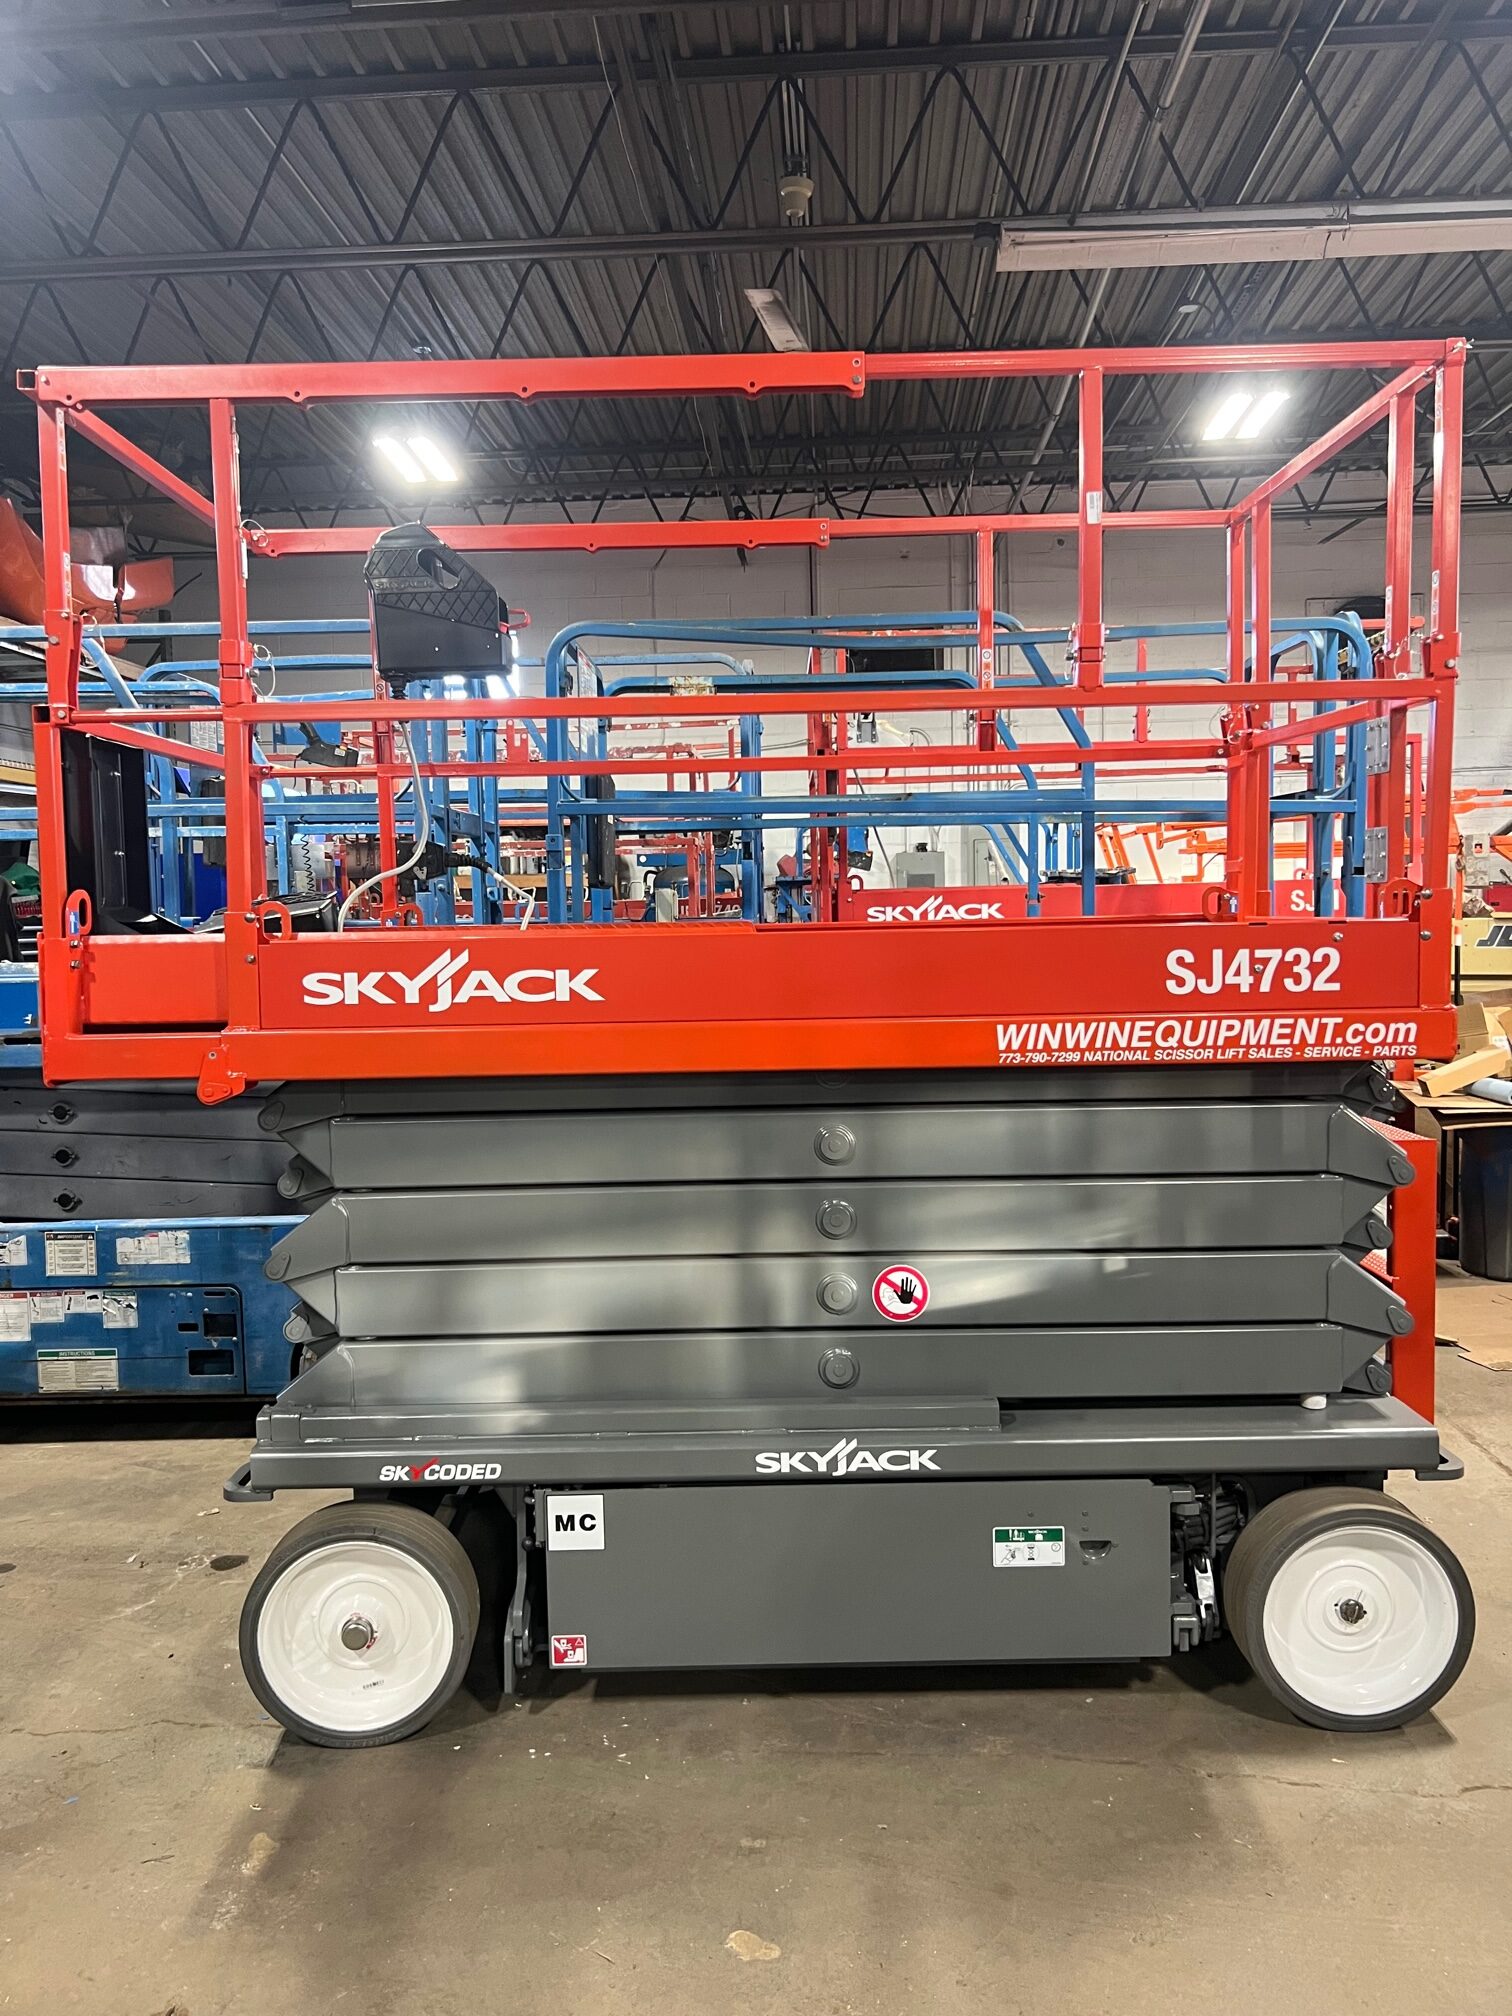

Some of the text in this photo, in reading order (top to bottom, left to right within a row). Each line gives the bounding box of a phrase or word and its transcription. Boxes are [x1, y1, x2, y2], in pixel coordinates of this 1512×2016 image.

[867, 895, 1005, 922] SKYJACK
[302, 948, 605, 1012] SKYJACK
[1165, 946, 1342, 996] SJ4732
[996, 1017, 1417, 1051] WINWINEQUIPMENT.com
[998, 1052, 1081, 1065] 773-790-7299
[1083, 1049, 1150, 1063] NATIONAL
[1154, 1048, 1214, 1061] SCISSOR
[1217, 1047, 1246, 1060] LIFT
[1248, 1046, 1292, 1059] SALES
[1303, 1045, 1362, 1058] SERVICE
[1373, 1044, 1418, 1057] PARTS
[379, 1458, 502, 1482] SKYCODED
[755, 1437, 942, 1476] SKYJACK
